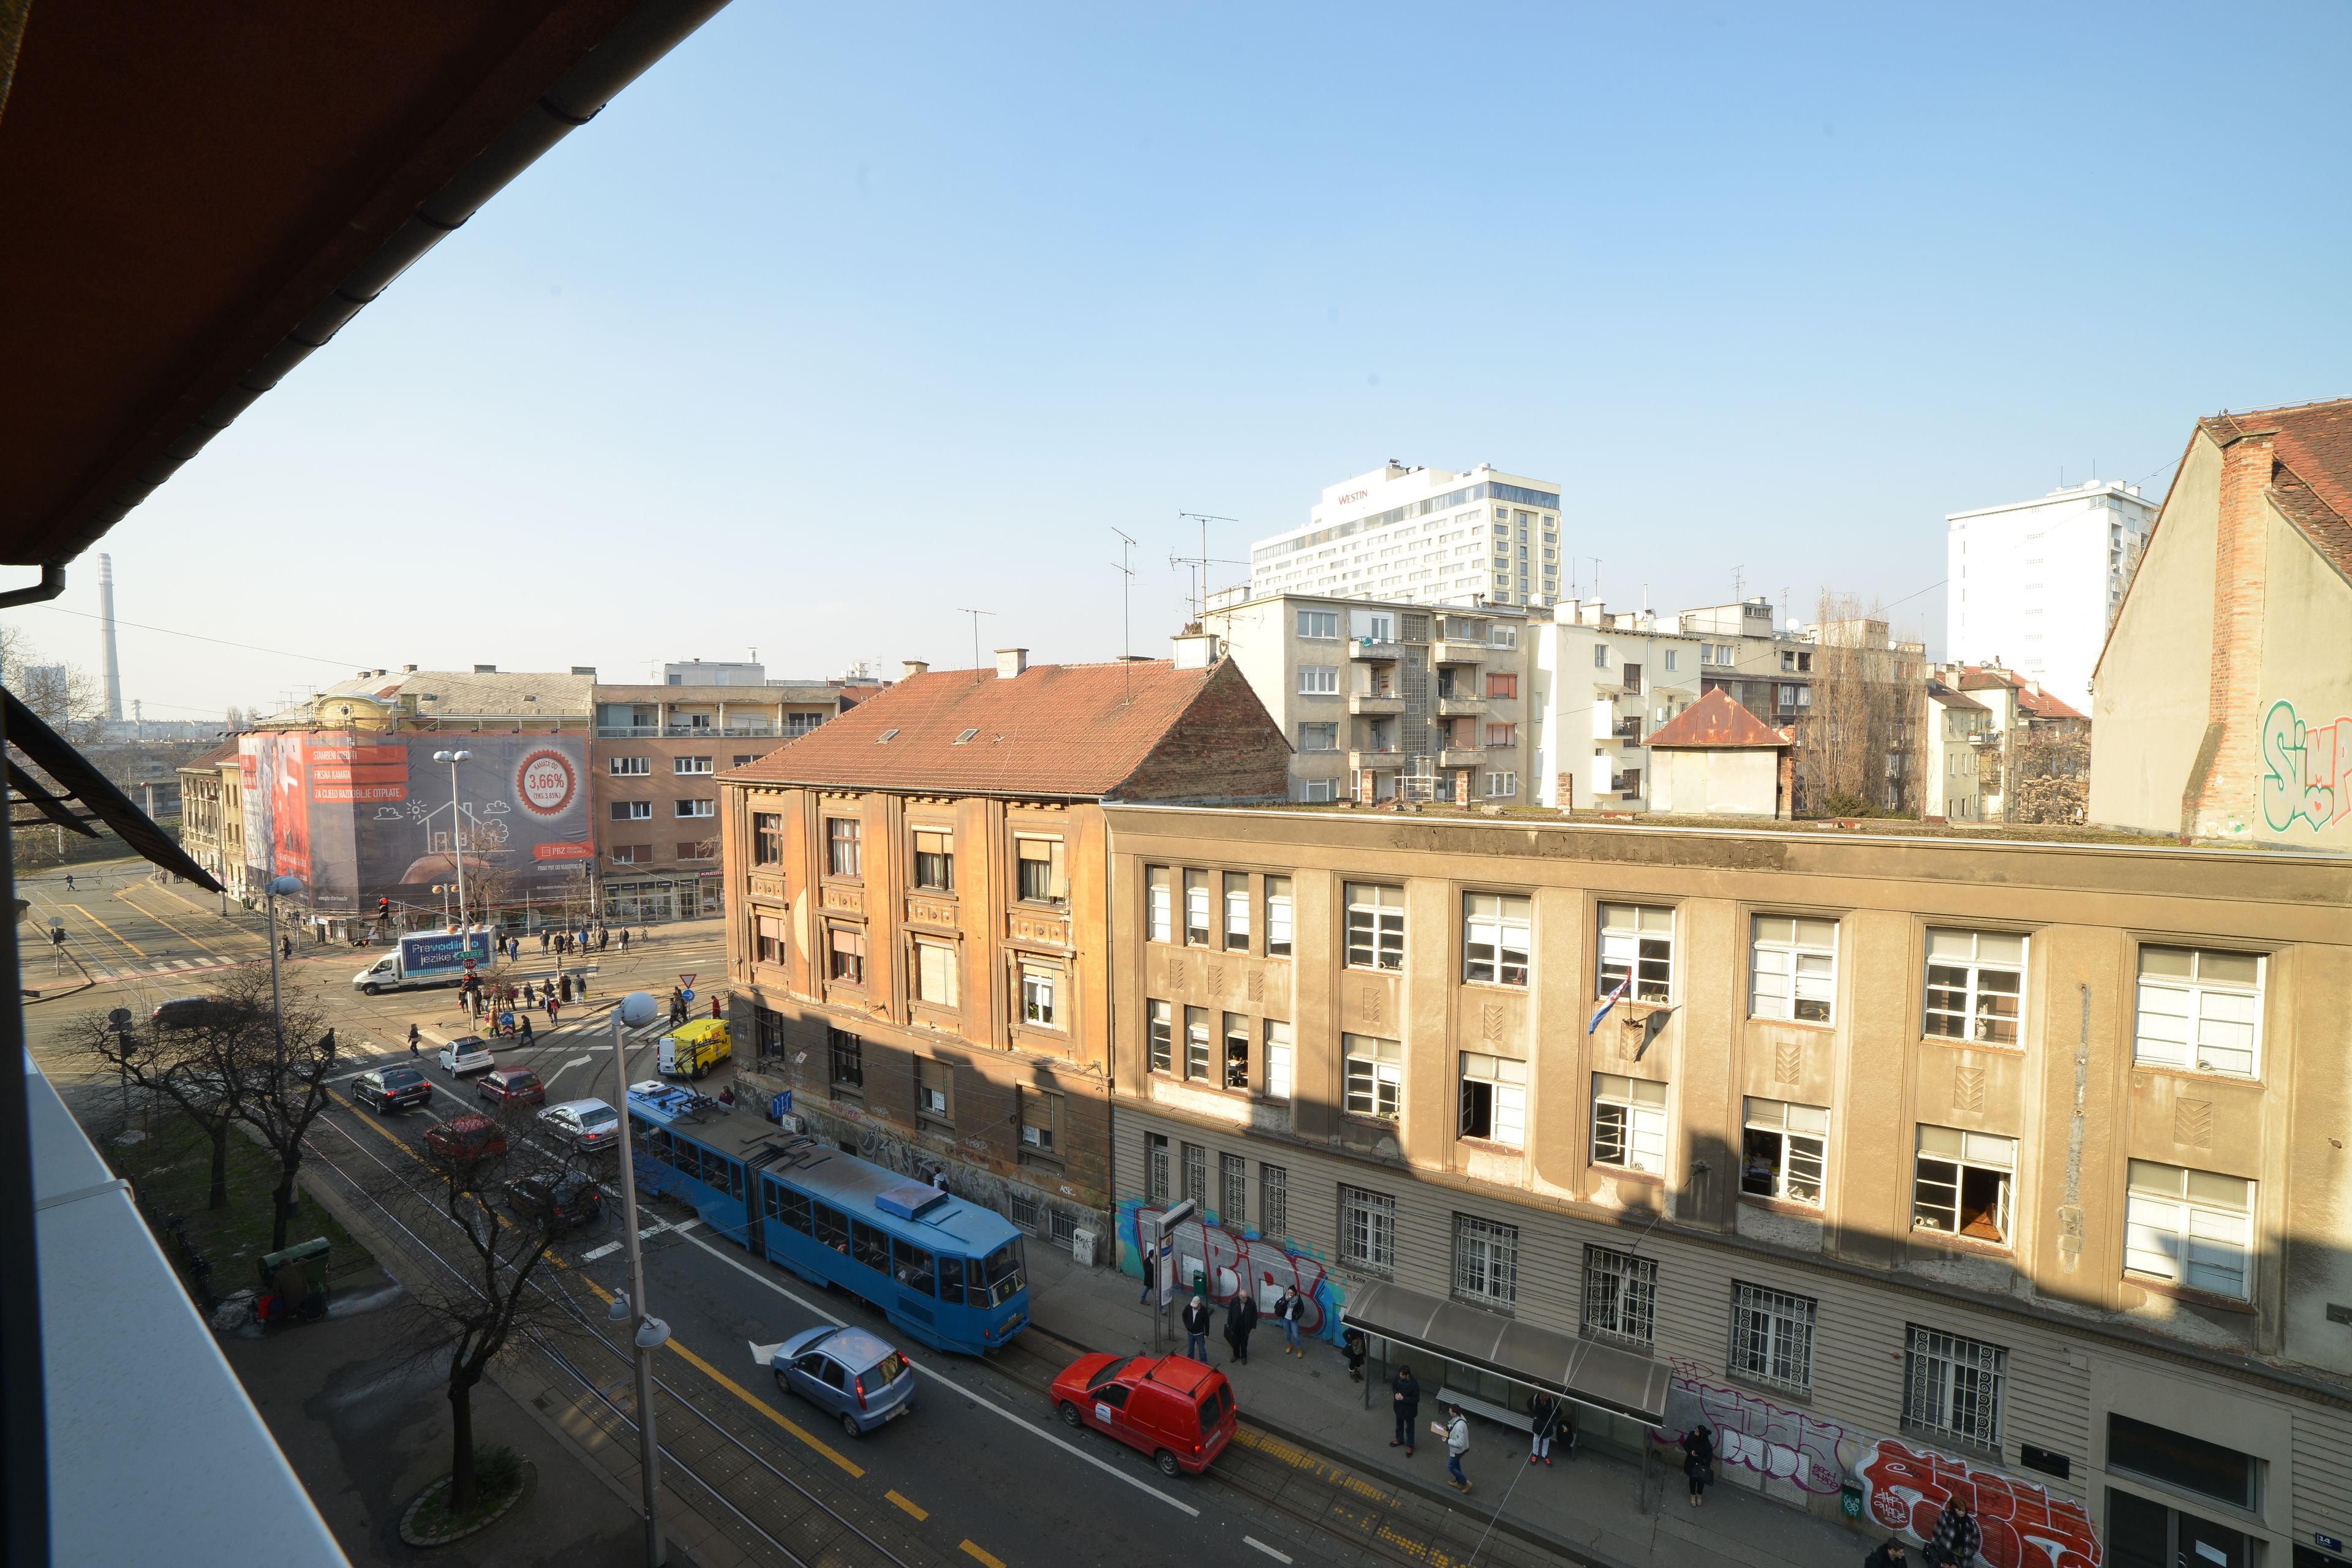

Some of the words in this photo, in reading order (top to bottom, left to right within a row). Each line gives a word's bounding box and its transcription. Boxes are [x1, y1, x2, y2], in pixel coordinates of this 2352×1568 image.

[1338, 489, 1368, 505] WESTIN
[313, 750, 336, 760] STAMBENI
[533, 760, 551, 771] KAMATA
[314, 770, 331, 780] FIKSNA
[331, 770, 351, 780] KAMATA
[529, 773, 564, 790] 3,66%
[315, 790, 322, 799] ZA
[322, 790, 337, 799] CIJELO
[339, 788, 371, 799] RAZDOBLJE
[372, 788, 402, 797] OTPLATE.
[412, 940, 479, 953] Prevodio
[420, 954, 451, 966] jezike
[1004, 1284, 1009, 1294] 9
[2319, 1535, 2331, 1545] 14
